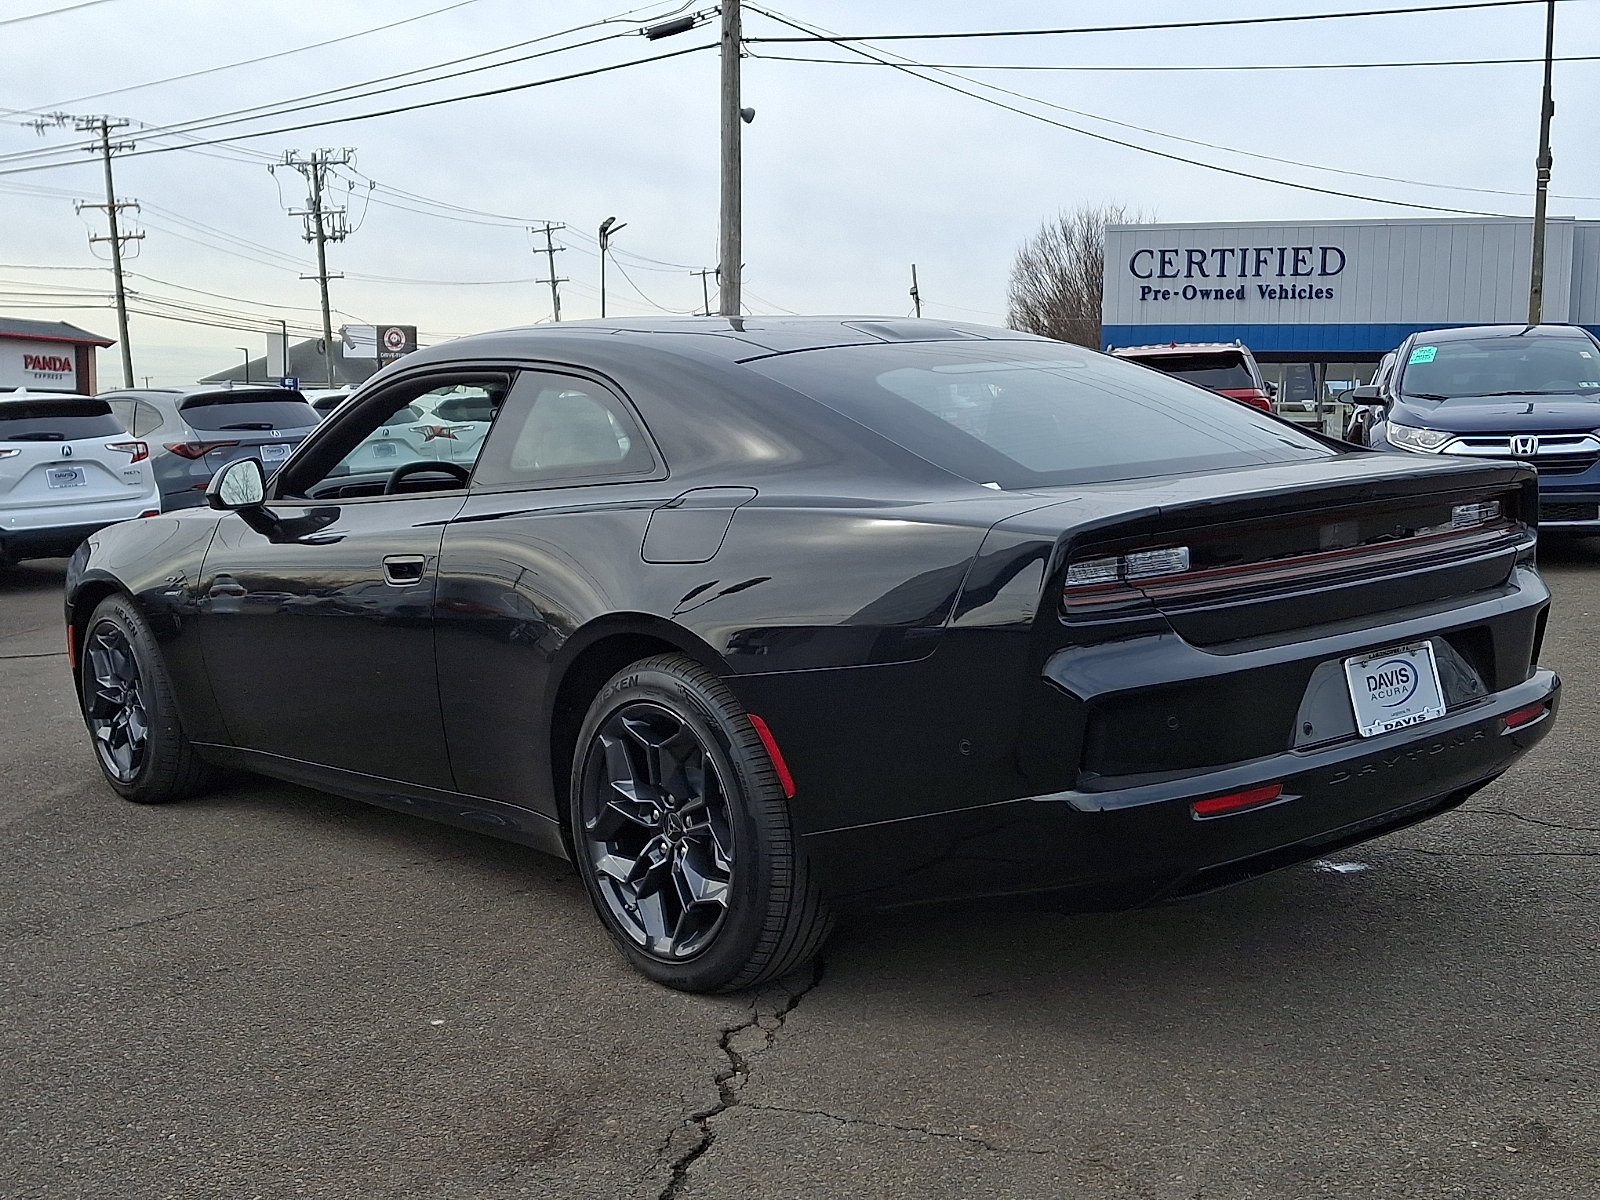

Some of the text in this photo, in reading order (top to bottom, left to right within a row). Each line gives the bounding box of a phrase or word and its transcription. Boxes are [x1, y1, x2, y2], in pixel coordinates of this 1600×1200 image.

[1129, 246, 1347, 280] CERTIFIED
[1139, 284, 1335, 302] Pre-Owned Vehicles
[23, 354, 72, 372] PANDA
[114, 606, 138, 637] NEXEN
[1365, 667, 1410, 692] DAVIS
[1371, 685, 1409, 701] ACURA
[1384, 714, 1426, 730] DAVIS
